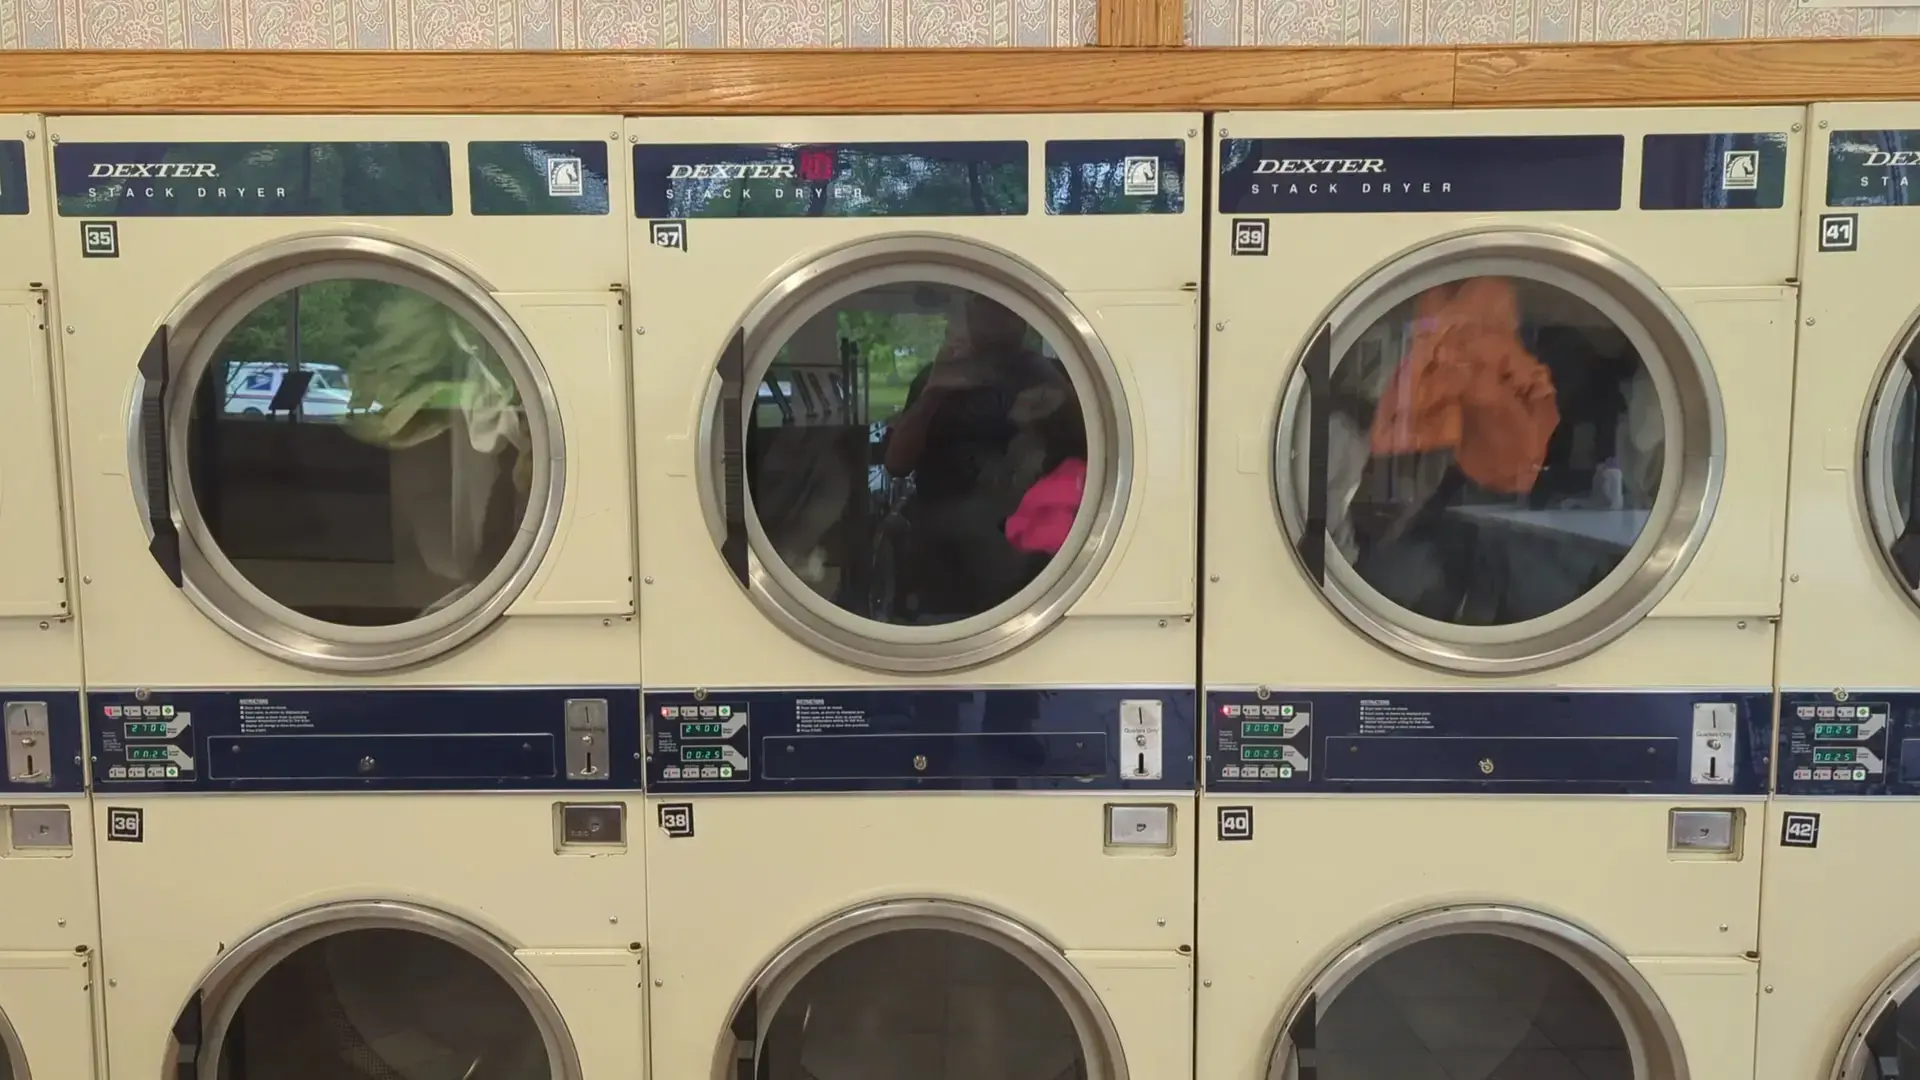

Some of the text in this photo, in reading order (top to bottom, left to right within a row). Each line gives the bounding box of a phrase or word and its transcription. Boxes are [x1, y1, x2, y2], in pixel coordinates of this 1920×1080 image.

[88, 163, 218, 178] DEXTER
[666, 164, 795, 179] DEXTER
[1253, 158, 1384, 174] DEXTER
[1251, 182, 1451, 194] STACK DRYER
[1860, 176, 1909, 187] STA
[88, 187, 286, 198] STACK DRYER
[666, 188, 862, 199] STACK DRYER
[1238, 230, 1262, 245] 39
[1826, 224, 1850, 239] 41
[88, 231, 112, 246] 35
[657, 231, 680, 246] 37
[114, 817, 137, 830] 36
[664, 814, 687, 827] 38
[1224, 817, 1247, 830] 40
[1789, 823, 1812, 836] 42
